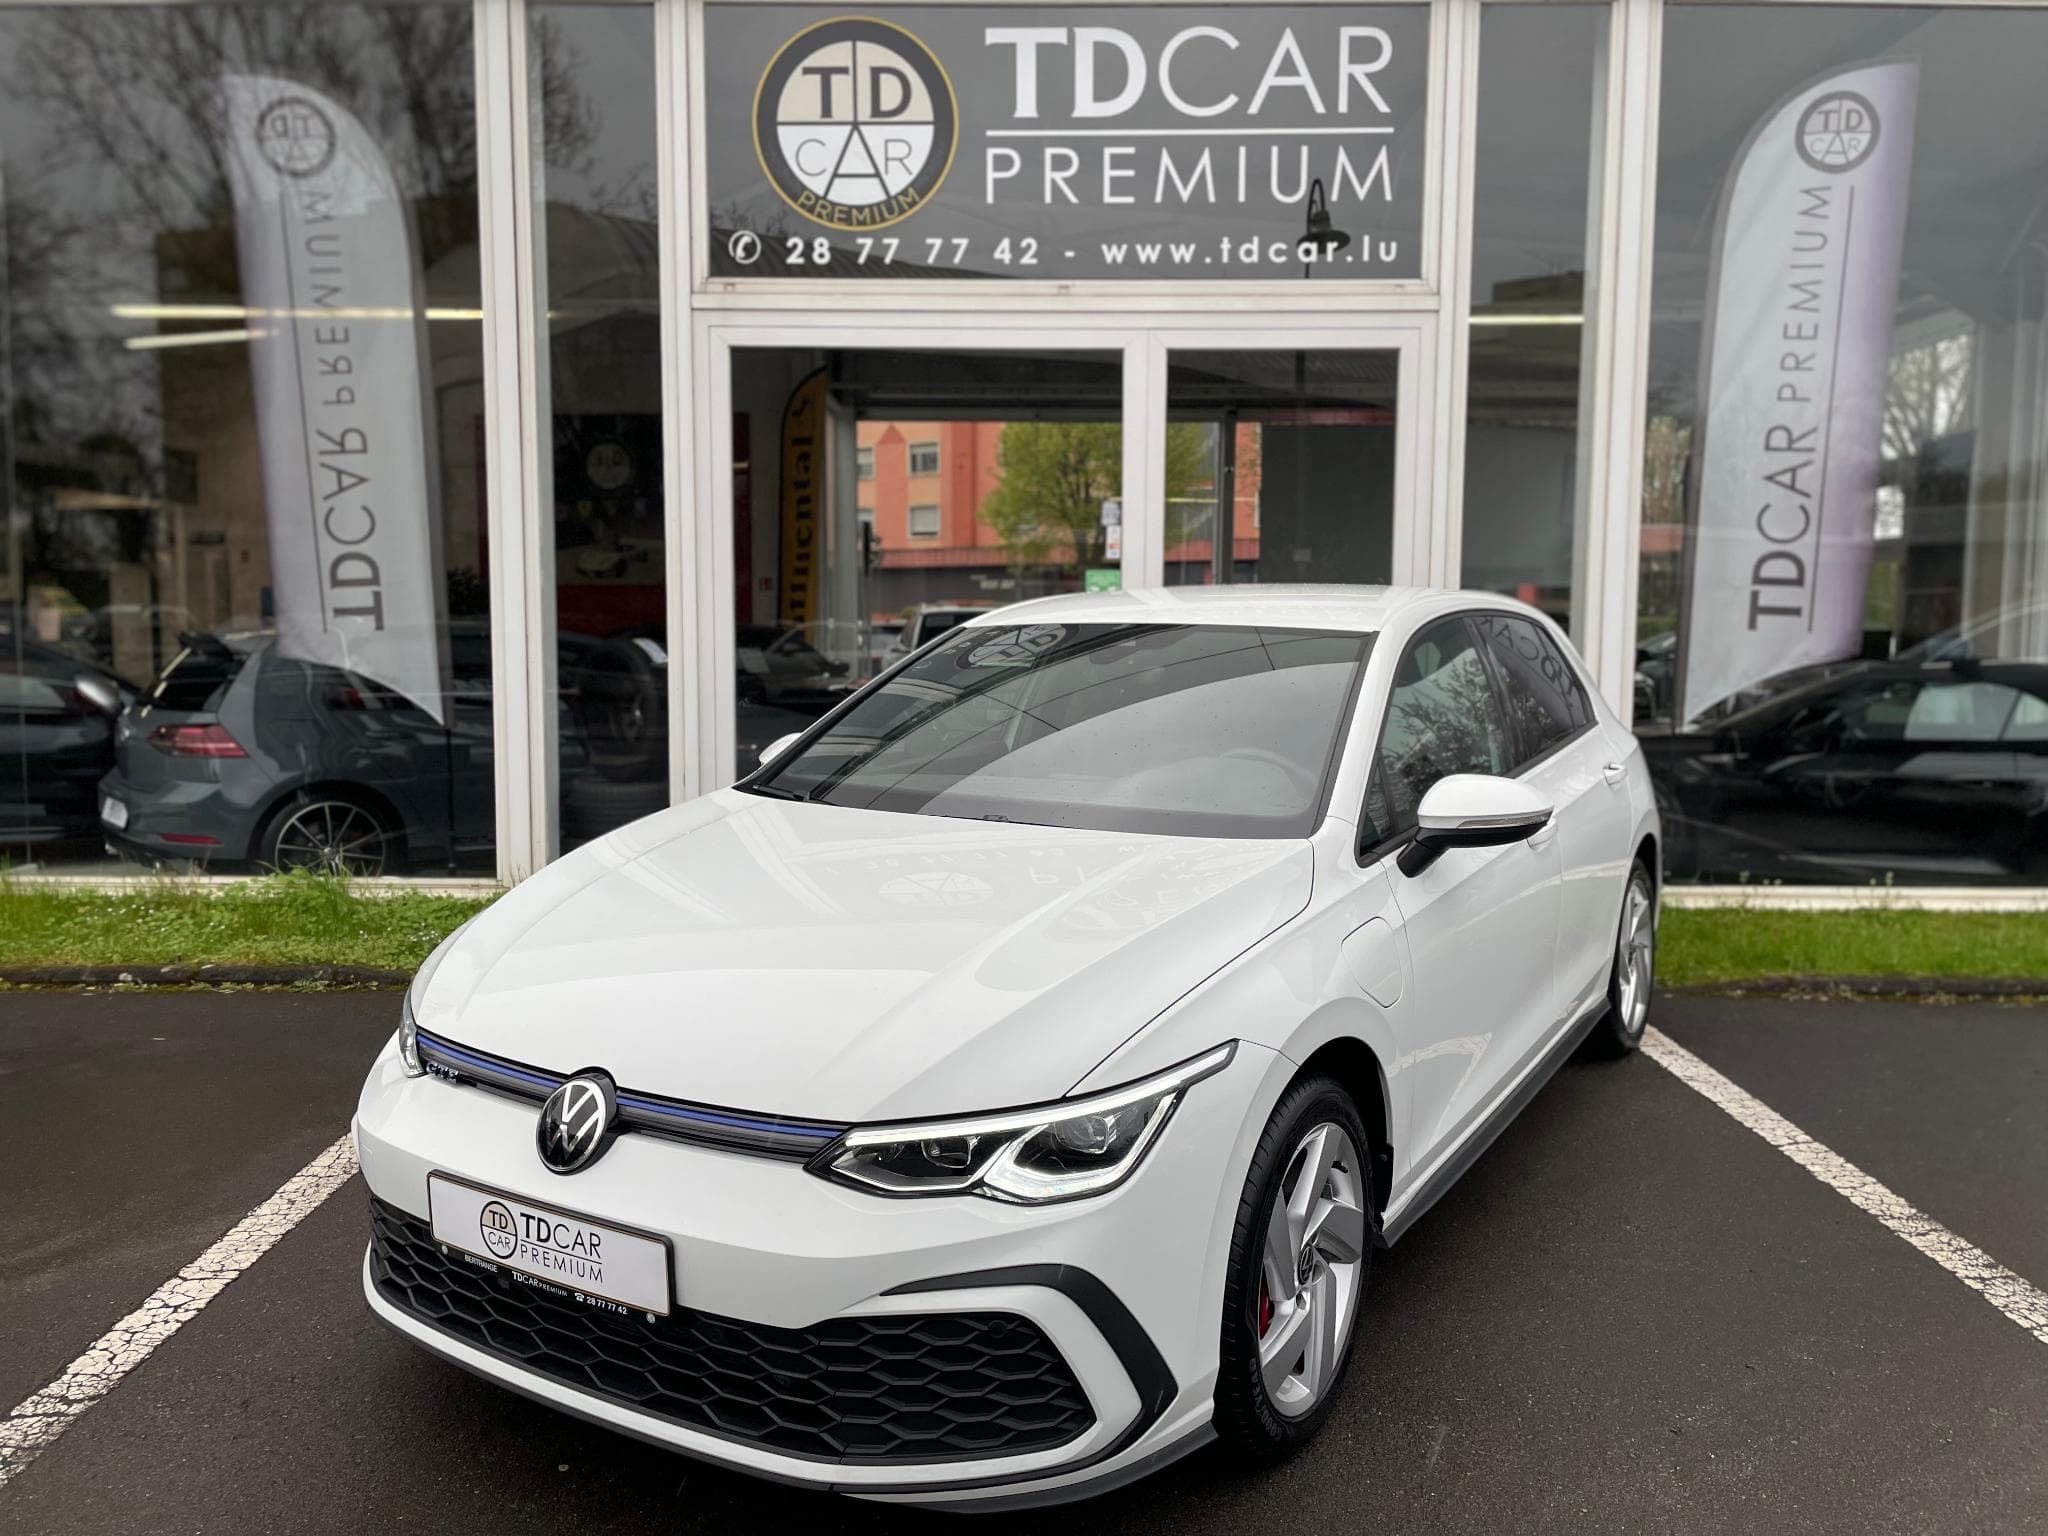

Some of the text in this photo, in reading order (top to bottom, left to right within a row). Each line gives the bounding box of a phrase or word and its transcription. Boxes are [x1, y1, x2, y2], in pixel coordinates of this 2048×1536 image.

[984, 25, 1393, 118] TDCAR
[795, 125, 913, 200] CAR
[985, 145, 1393, 205] PREMIUM
[797, 187, 920, 227] PREMIUM
[785, 237, 831, 265] 28
[855, 237, 900, 265] 77
[925, 237, 970, 265] 77
[992, 237, 1039, 265] 42
[1100, 236, 1399, 266] www.tdcar.lu
[1747, 186, 1832, 631] TDCAR PREMIUM
[487, 1231, 511, 1251] CAR
[488, 1209, 508, 1231] TD
[519, 1211, 602, 1260] TDCAR
[519, 1242, 604, 1284] PREMIUM
[617, 1305, 628, 1315] 42
